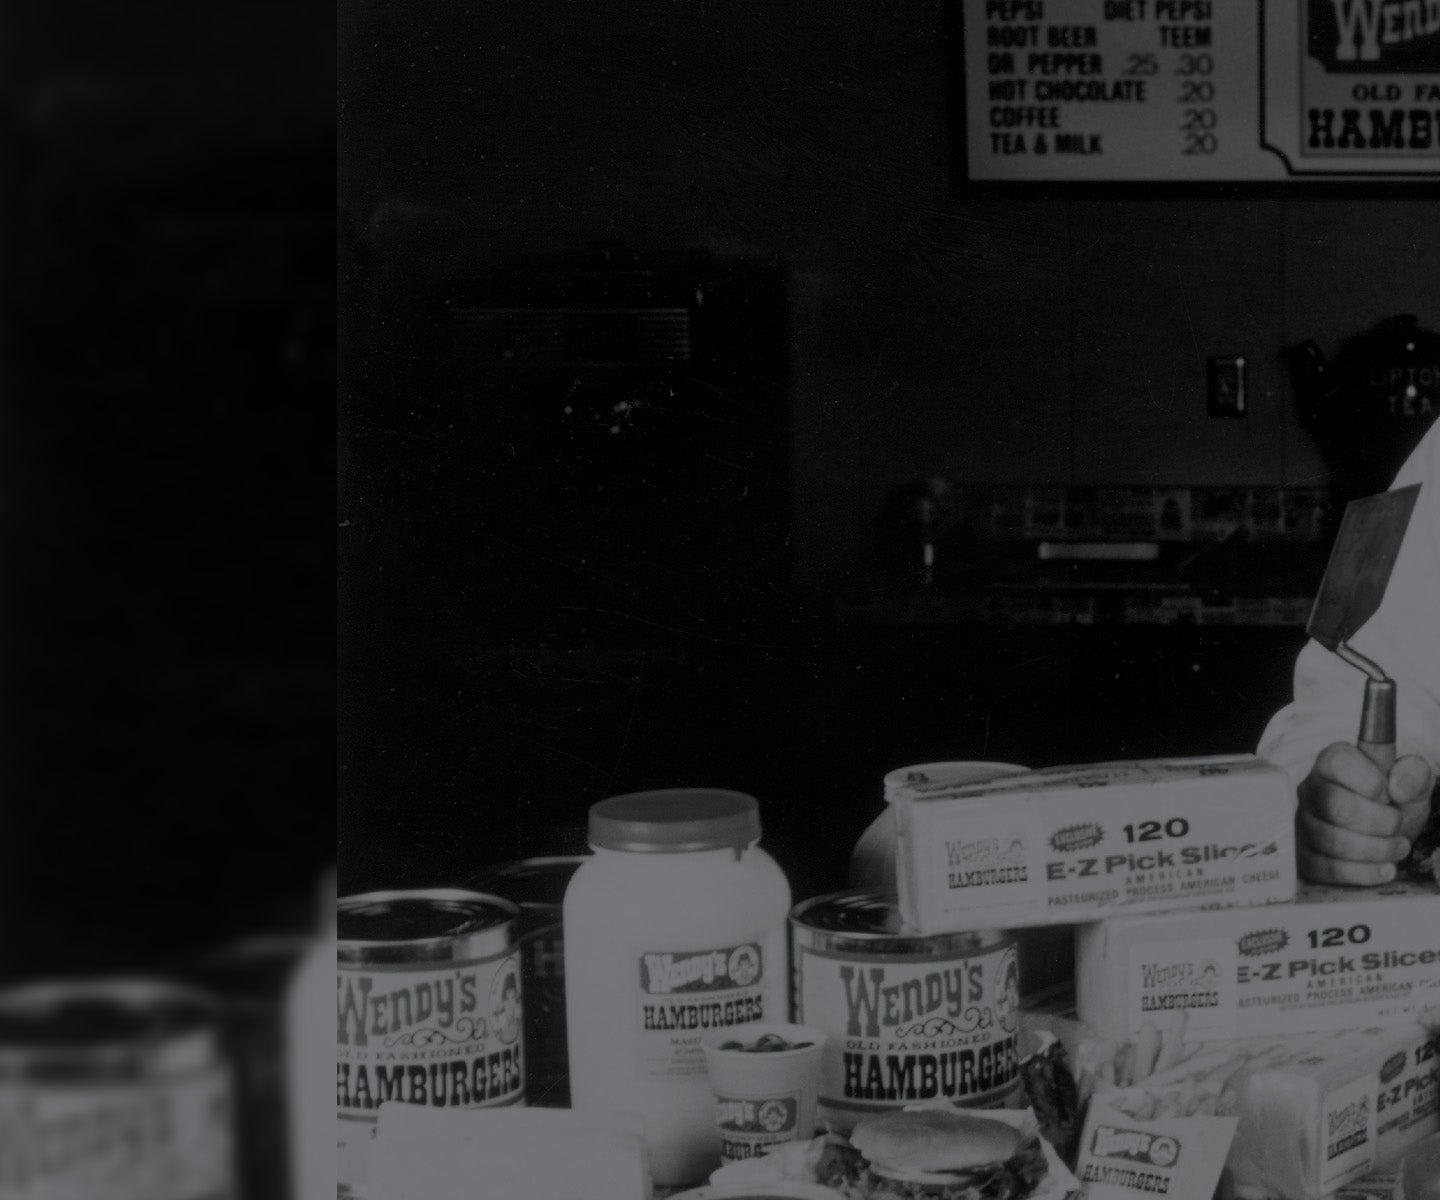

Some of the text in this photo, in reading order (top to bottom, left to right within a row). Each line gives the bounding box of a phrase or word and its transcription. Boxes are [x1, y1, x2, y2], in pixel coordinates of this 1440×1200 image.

[986, 0, 1044, 21] PEPSI
[1104, 0, 1213, 21] DIET PEPSI
[987, 24, 1098, 48] ROOT BEER
[1159, 25, 1212, 48] TEEM
[988, 52, 1215, 77] DR PEPPER .25 .30
[989, 79, 1216, 103] HOT CHOCOLATE .20
[1352, 83, 1402, 102] OLD
[989, 106, 1218, 132] COFFEE .20
[990, 132, 1220, 157] TEA & MILK .20
[1387, 393, 1432, 416] TEA
[1122, 816, 1190, 844] 120
[948, 865, 1029, 890] HAMBURGERS
[1046, 857, 1100, 882] E-Z
[1104, 849, 1176, 875] Pick
[1125, 867, 1204, 886] AMERICAN
[1047, 889, 1120, 907] PASTEURIZED
[1125, 882, 1174, 897] PROCESS
[1179, 875, 1236, 891] AMERICAN
[1241, 869, 1281, 885] CHEESE
[1307, 924, 1372, 949] 120
[1237, 962, 1282, 984] E-Z
[1288, 955, 1356, 979] Pick
[1306, 972, 1383, 990] AMERICAN
[839, 960, 984, 1038] Wendy's
[1141, 991, 1219, 1012] HAMBURGERS
[1238, 992, 1301, 1009] ASTEURIZED
[1306, 986, 1354, 1001] PROCESS
[1359, 981, 1413, 997] AMERICAN
[337, 969, 477, 1047] Wendy's
[643, 994, 764, 1030] HAMBURGERS
[376, 1045, 487, 1062] FASHIONED
[846, 1031, 992, 1051] OLD FASHIONED
[843, 1032, 1019, 1100] HAMBURGER
[1376, 1083, 1402, 1113] E-Z
[1082, 1164, 1171, 1195] HAMBURGERS
